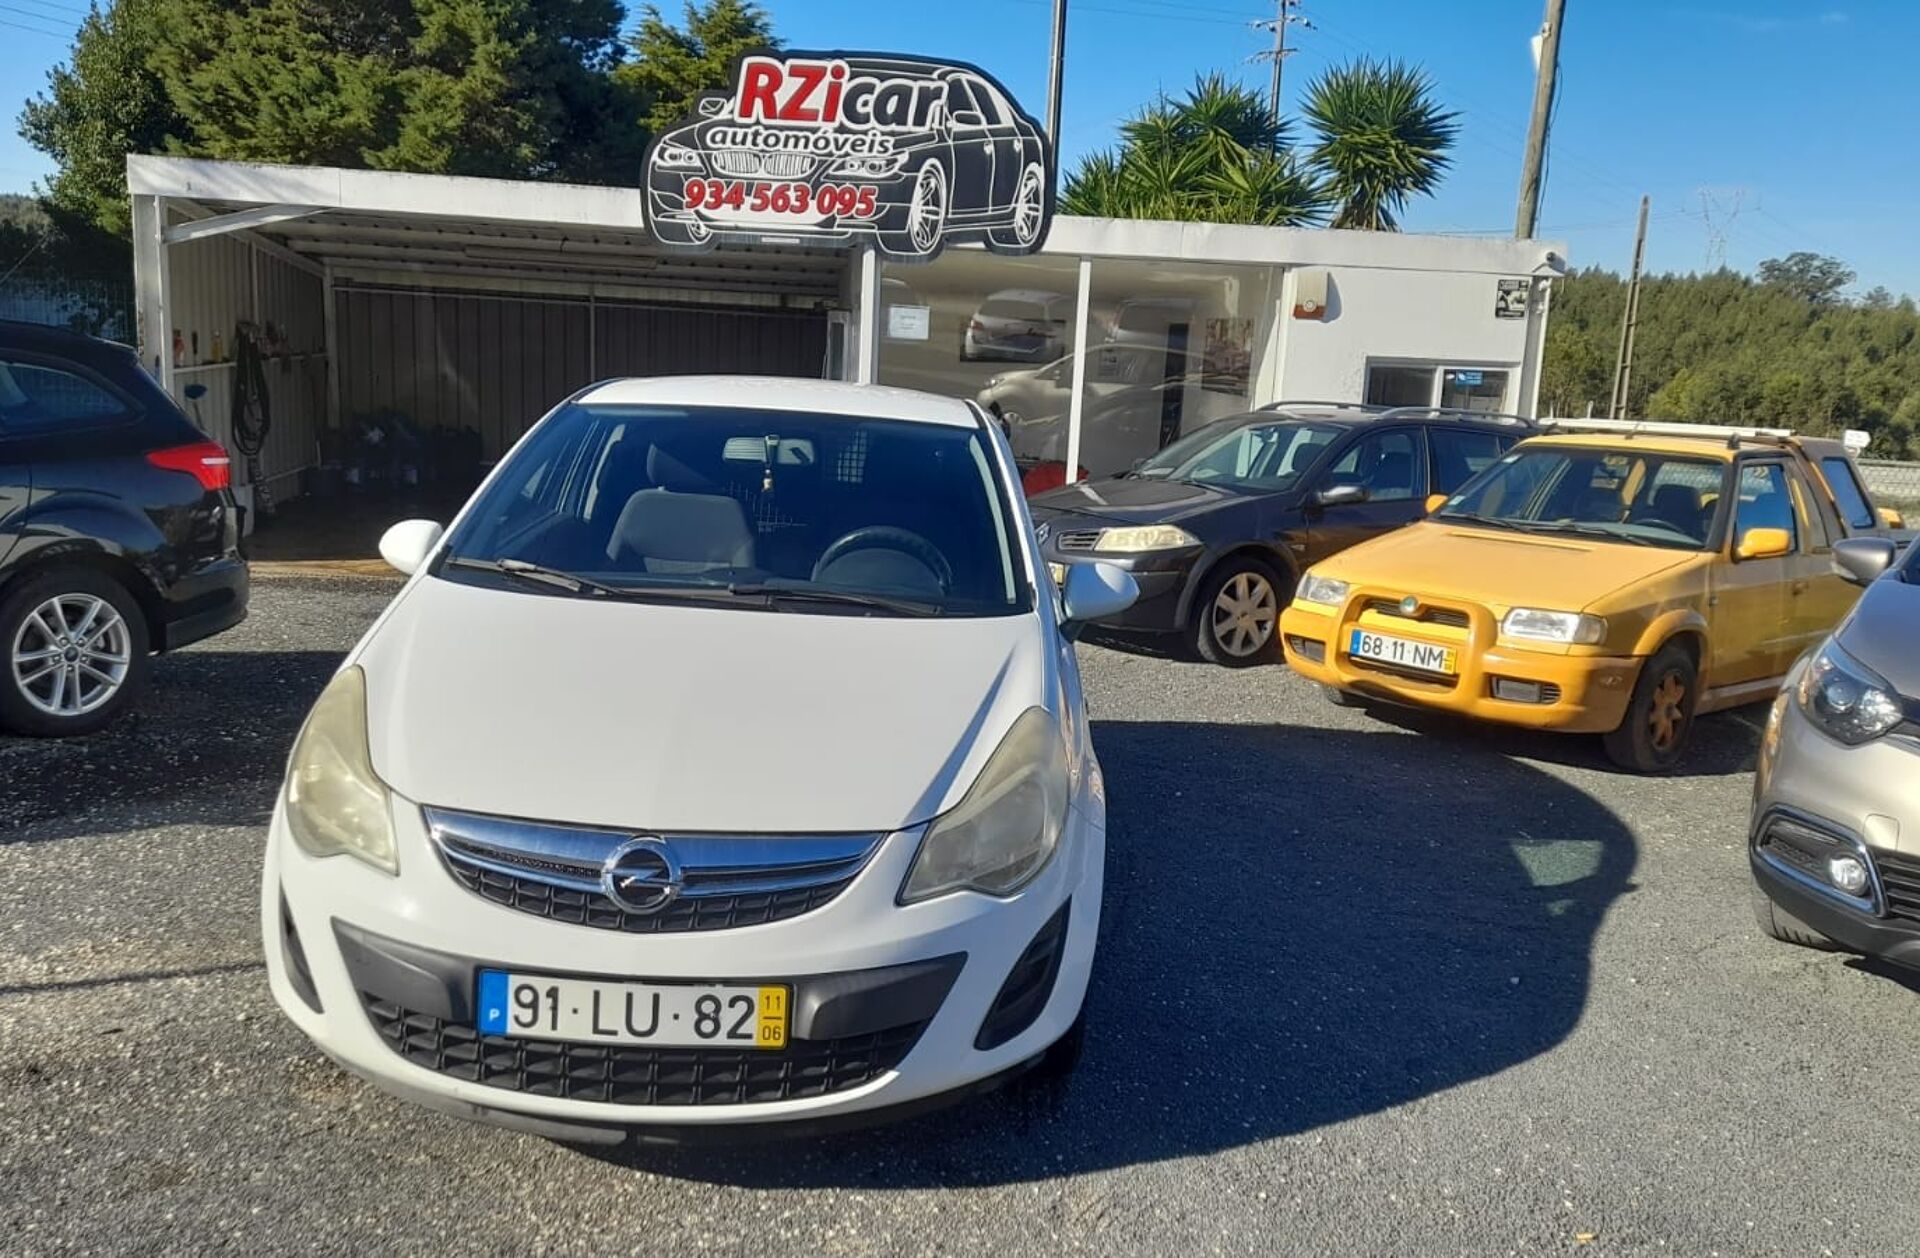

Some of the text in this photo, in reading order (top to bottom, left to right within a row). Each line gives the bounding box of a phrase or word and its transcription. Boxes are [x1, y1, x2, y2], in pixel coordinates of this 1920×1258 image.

[739, 62, 942, 127] RZicar
[708, 129, 890, 154] automóveis
[685, 179, 876, 217] 934 563 095
[489, 1009, 499, 1020] P
